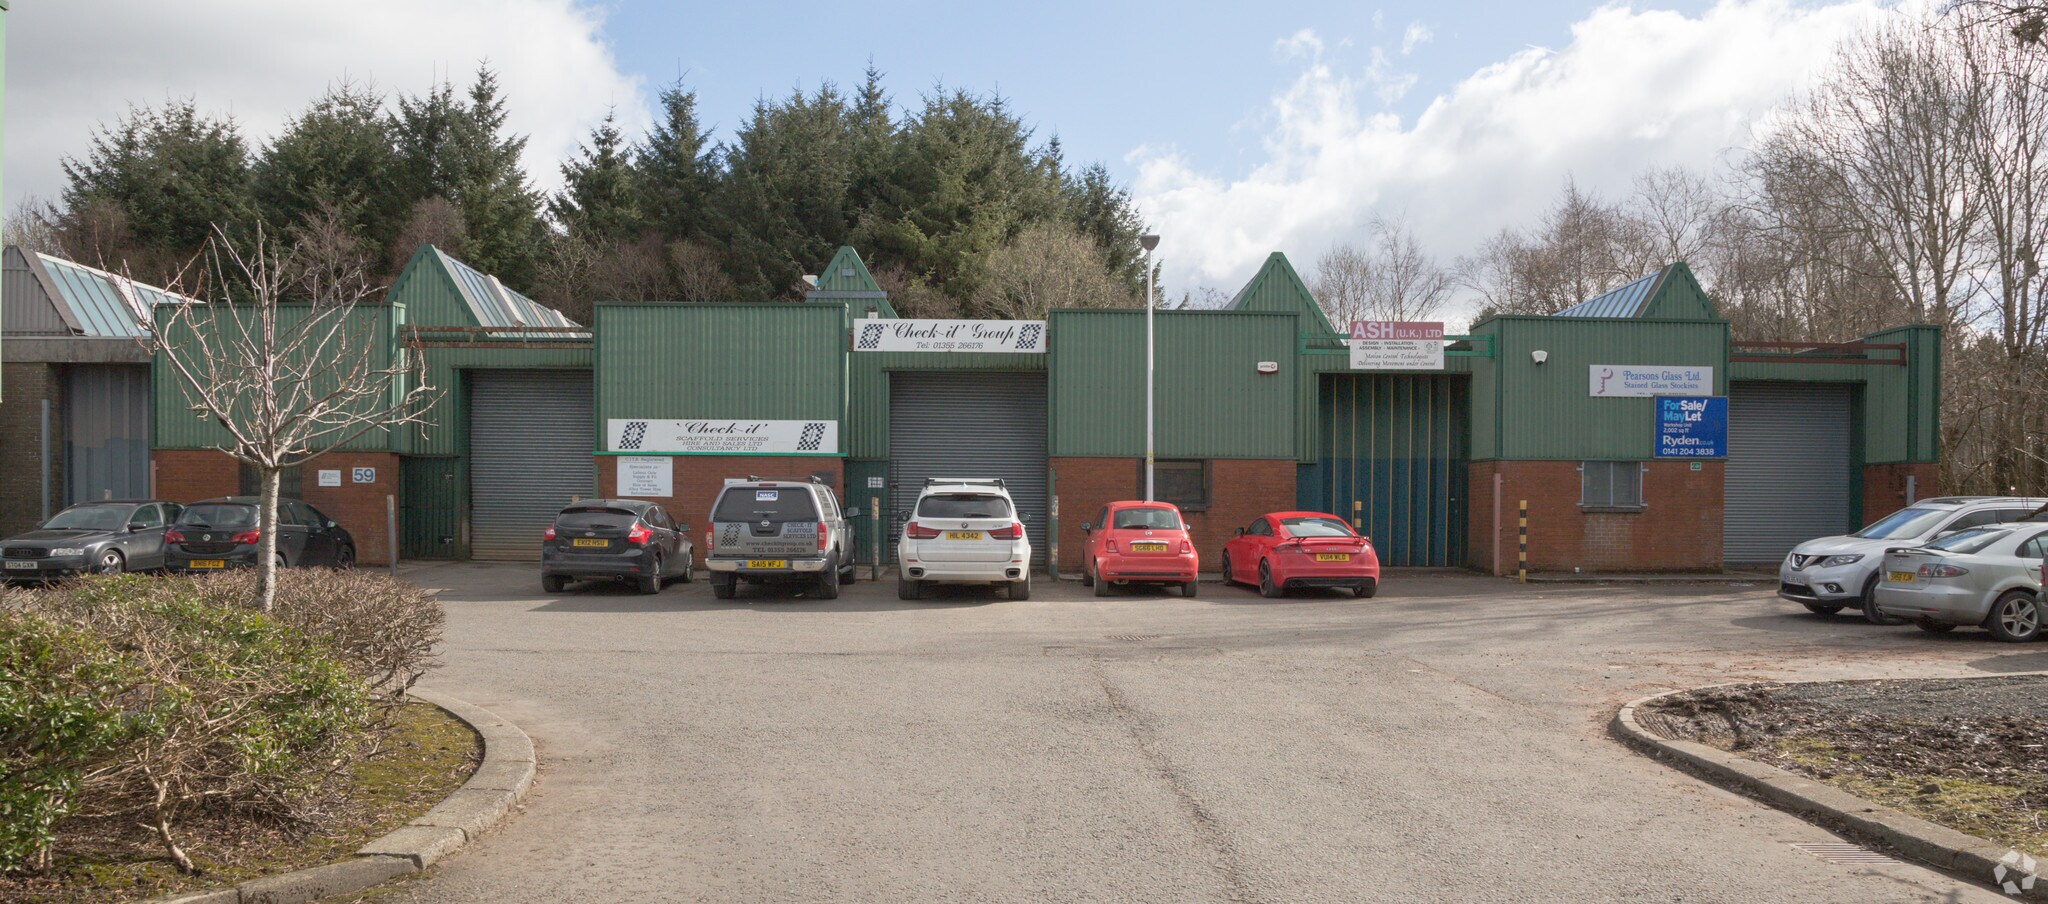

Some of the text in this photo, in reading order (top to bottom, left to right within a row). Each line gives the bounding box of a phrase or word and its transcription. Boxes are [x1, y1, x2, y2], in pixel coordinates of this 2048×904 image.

[972, 323, 1015, 344] Group
[1353, 322, 1442, 339] ASH (U.K.) LTD
[1623, 370, 1702, 381] Pearsons Glass Ltd.
[354, 469, 374, 482] 59
